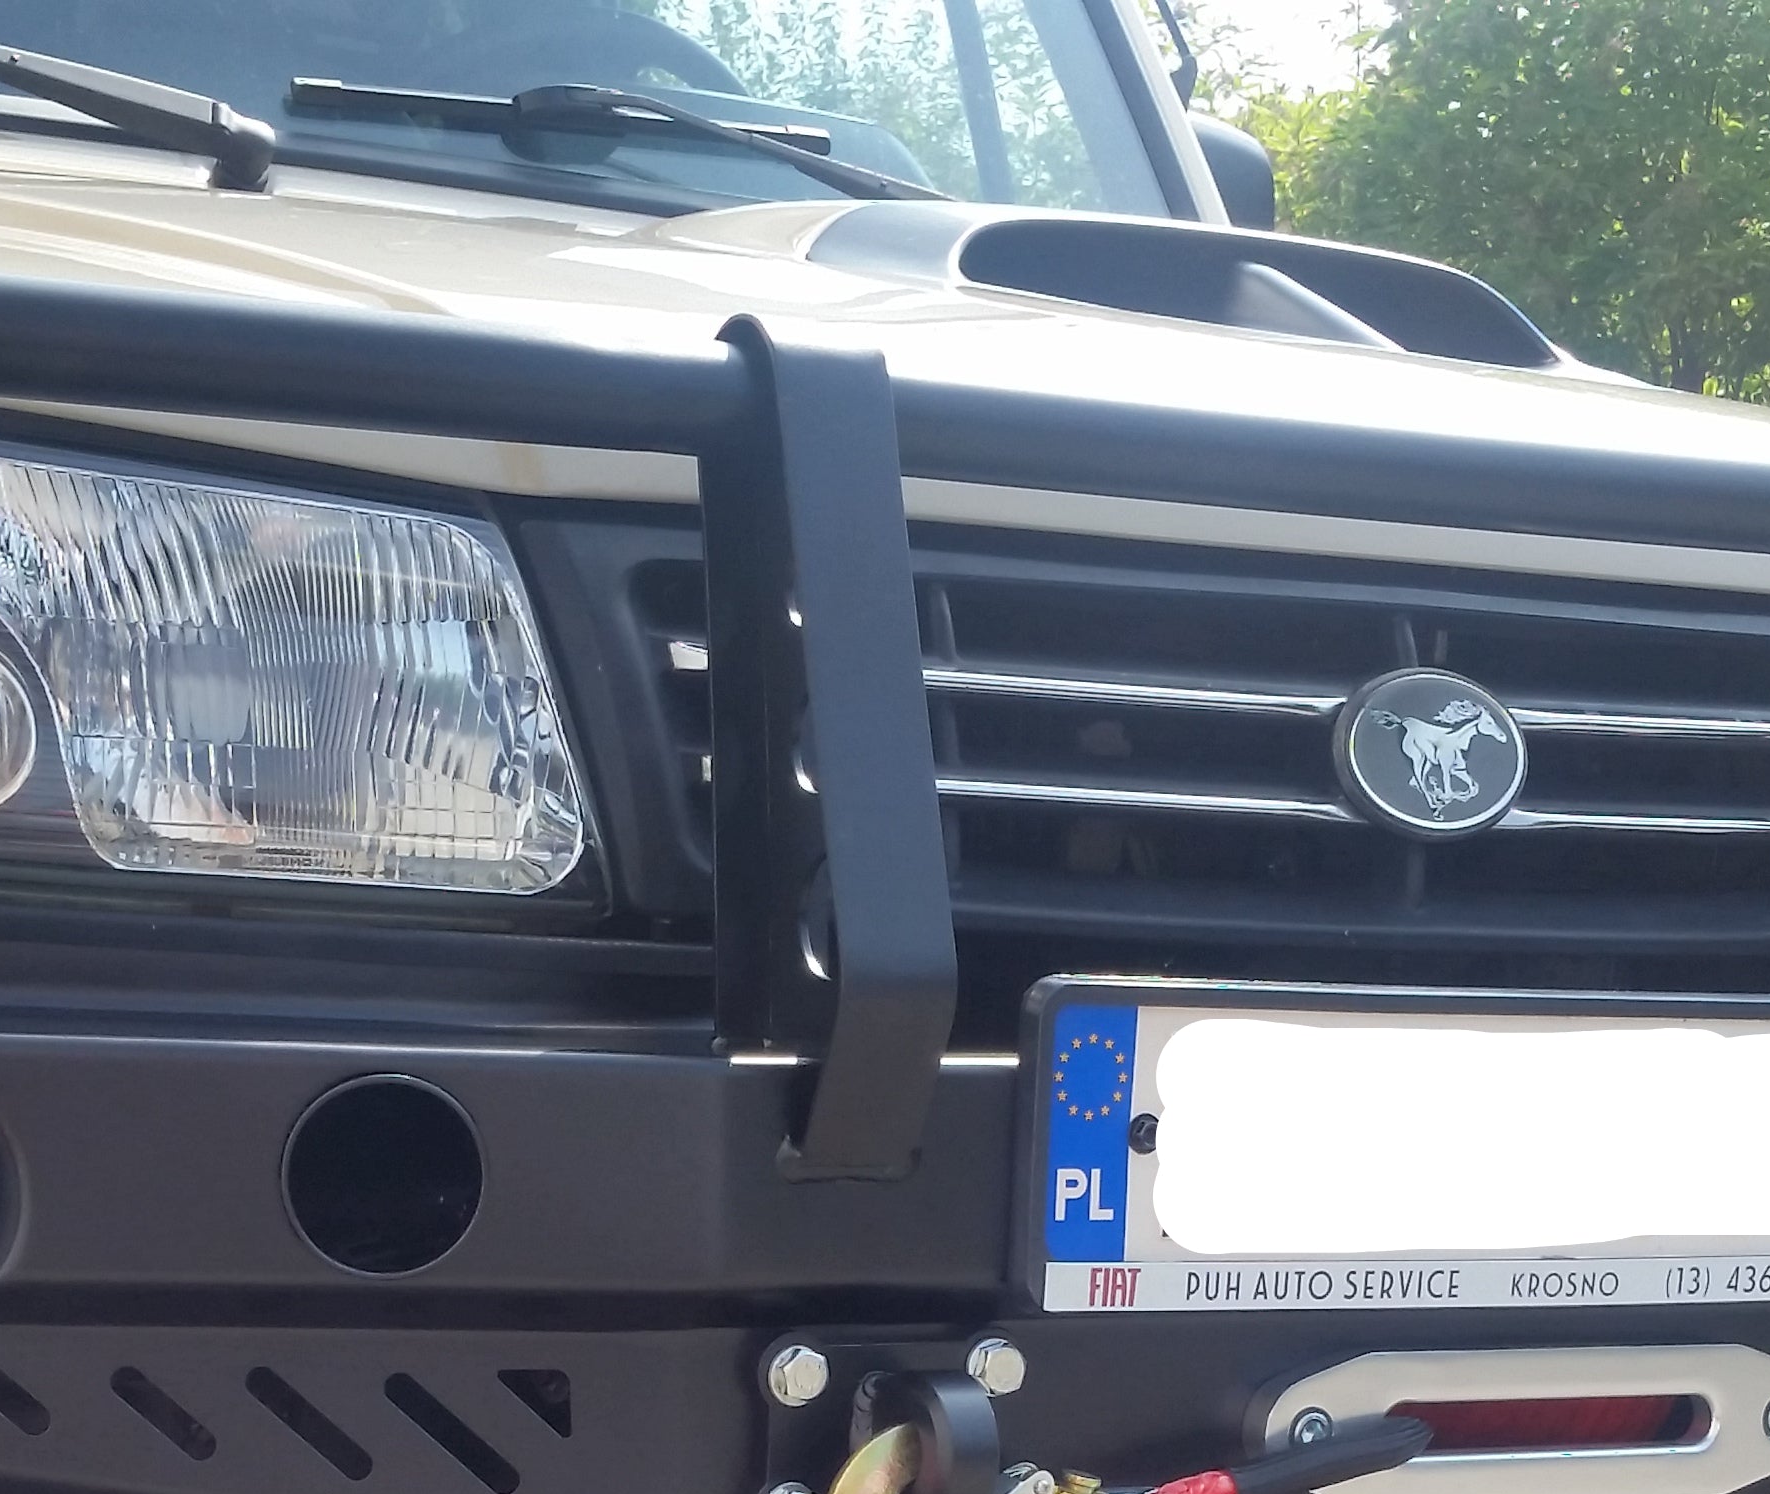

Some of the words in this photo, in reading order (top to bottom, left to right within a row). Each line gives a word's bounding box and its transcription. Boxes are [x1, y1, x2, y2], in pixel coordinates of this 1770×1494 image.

[1054, 1167, 1114, 1221] PL
[1088, 1267, 1141, 1307] FIAT
[1185, 1271, 1240, 1301] PUH
[1253, 1270, 1333, 1301] AUTO
[1343, 1270, 1460, 1300] SERVICE
[1510, 1271, 1619, 1298] KROSNO
[1665, 1266, 1711, 1298] (13)
